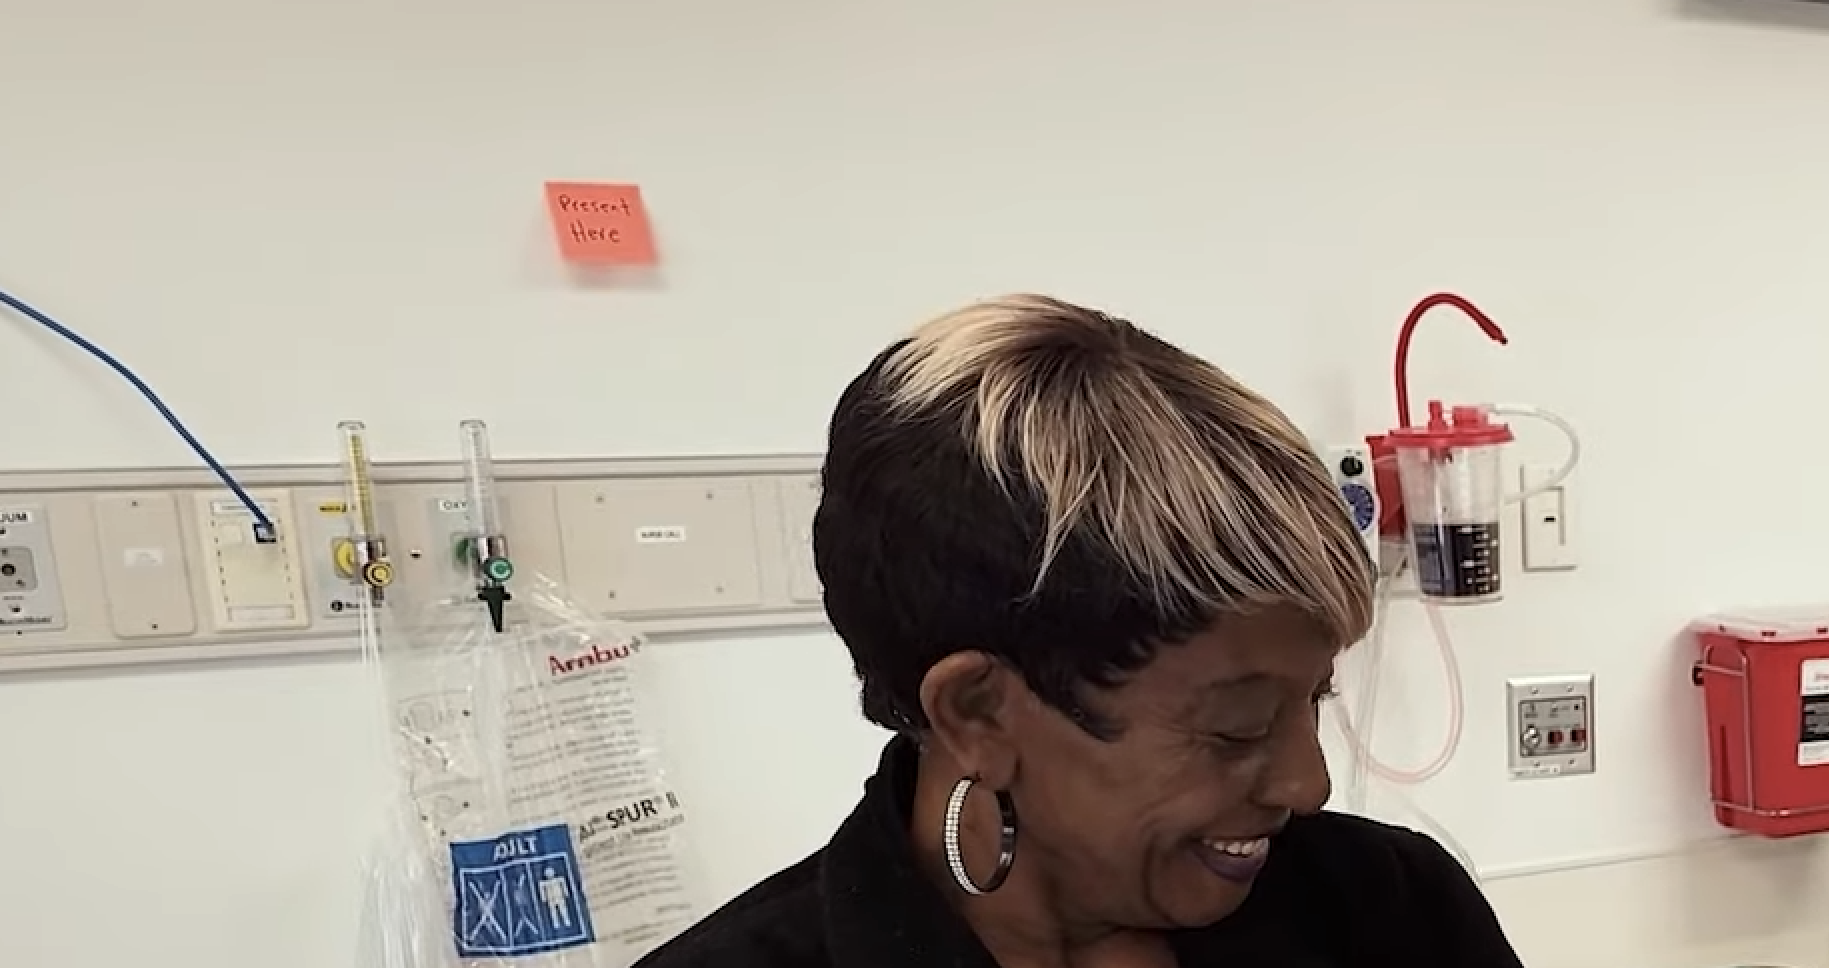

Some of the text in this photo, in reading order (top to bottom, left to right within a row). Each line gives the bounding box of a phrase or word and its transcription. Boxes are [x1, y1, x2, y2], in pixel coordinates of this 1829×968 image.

[558, 193, 631, 217] Present
[569, 217, 621, 244] Here
[547, 643, 630, 677] Ambu
